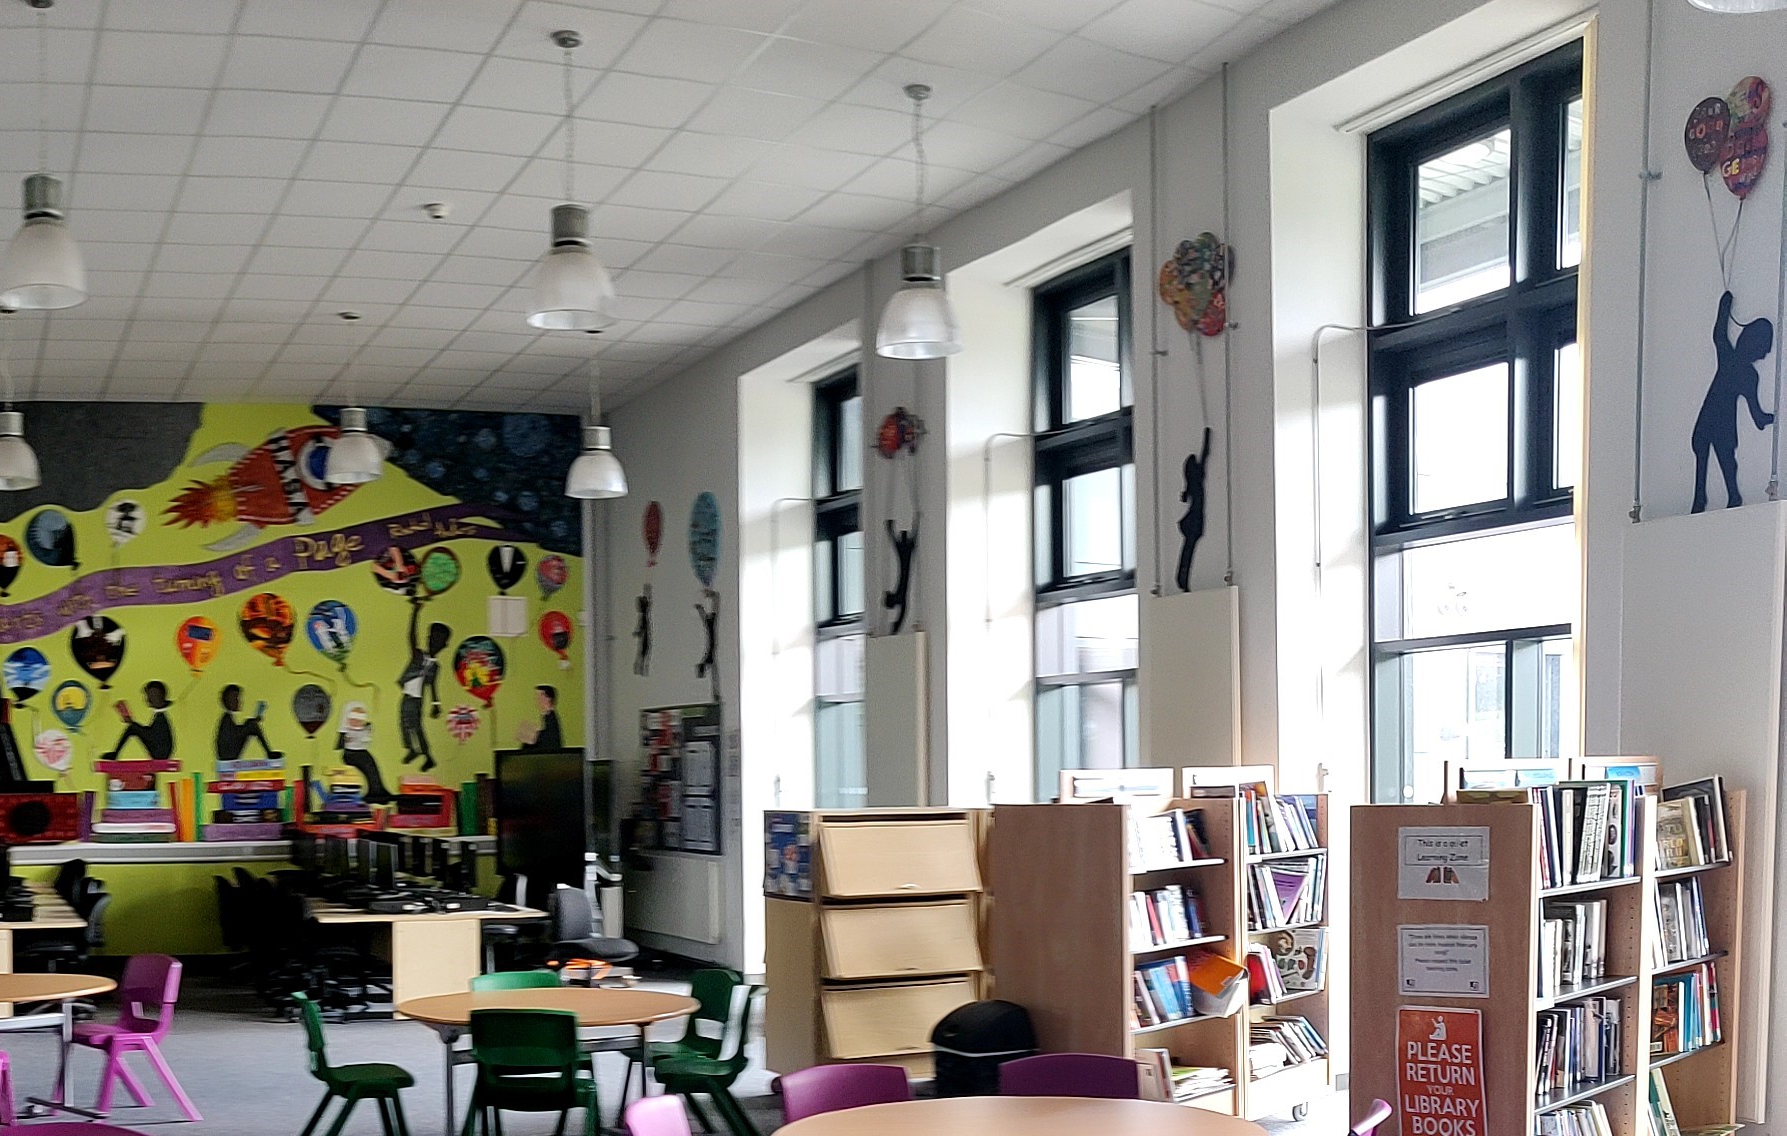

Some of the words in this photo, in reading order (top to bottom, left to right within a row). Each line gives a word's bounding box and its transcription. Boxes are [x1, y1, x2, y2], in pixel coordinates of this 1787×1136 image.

[292, 535, 364, 569] Page
[1407, 1041, 1473, 1065] PLEASE
[1405, 1062, 1476, 1086] RETURN
[1426, 1084, 1455, 1096] YOUR
[1404, 1094, 1481, 1118] LIBRARY
